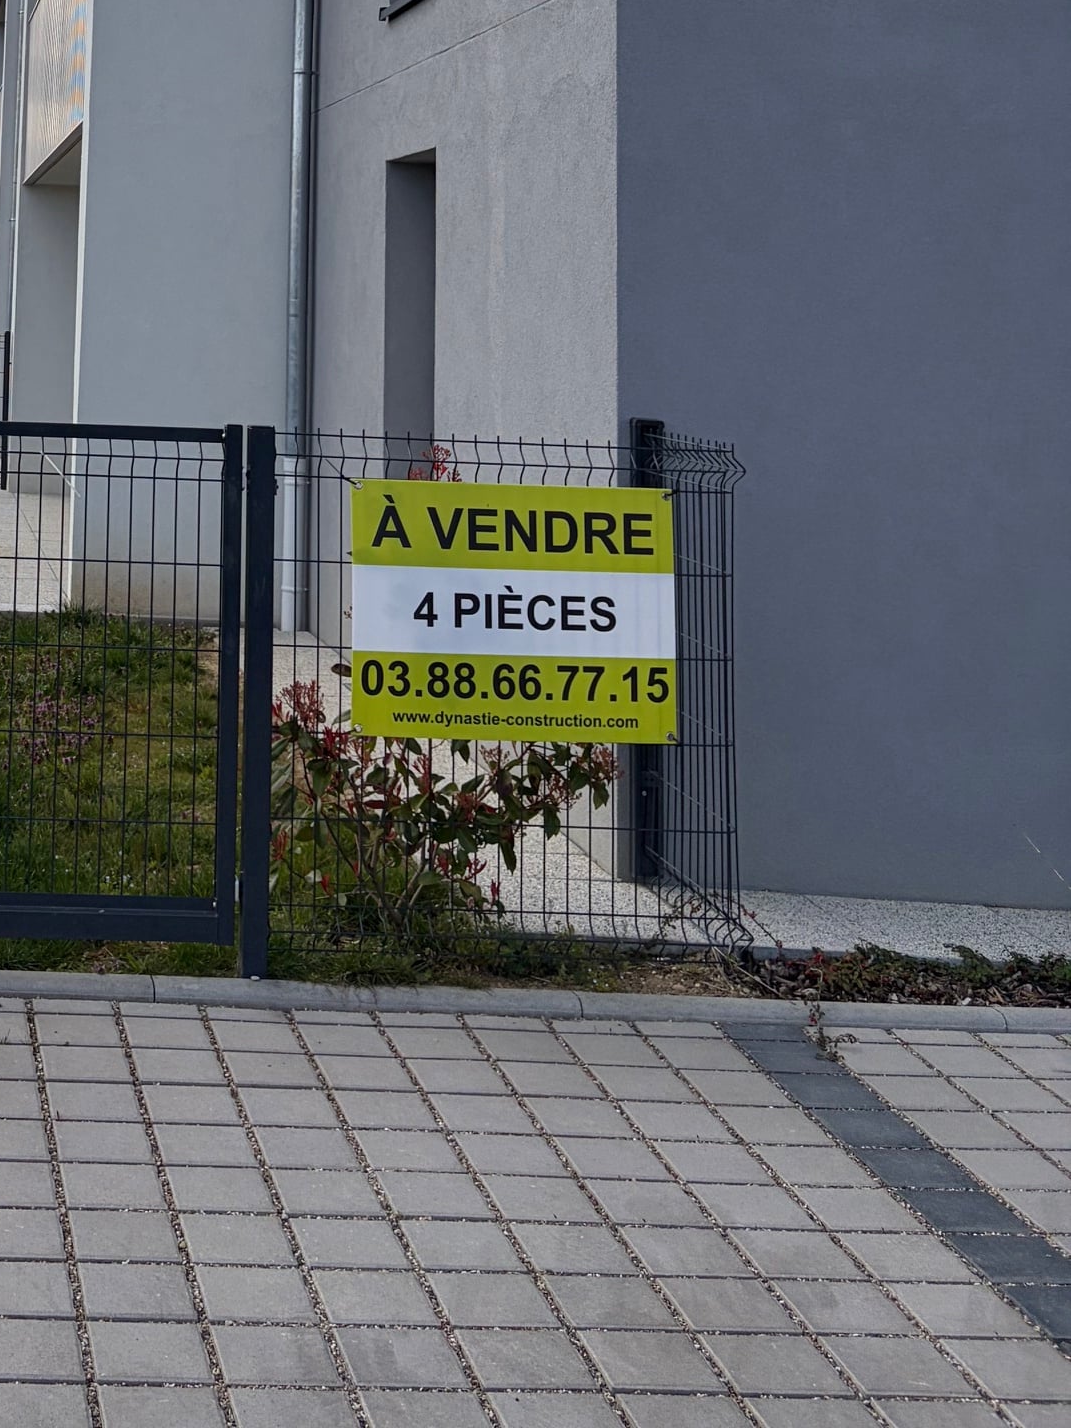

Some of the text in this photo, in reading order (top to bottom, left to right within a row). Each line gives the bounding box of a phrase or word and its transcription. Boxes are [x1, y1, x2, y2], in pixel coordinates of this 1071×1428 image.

[371, 494, 655, 556] À VENDRE
[413, 585, 617, 632] 4 PIÈCES
[361, 659, 670, 704] 03.88.66.77.15
[392, 710, 639, 729] www.dynastie-construction.com
